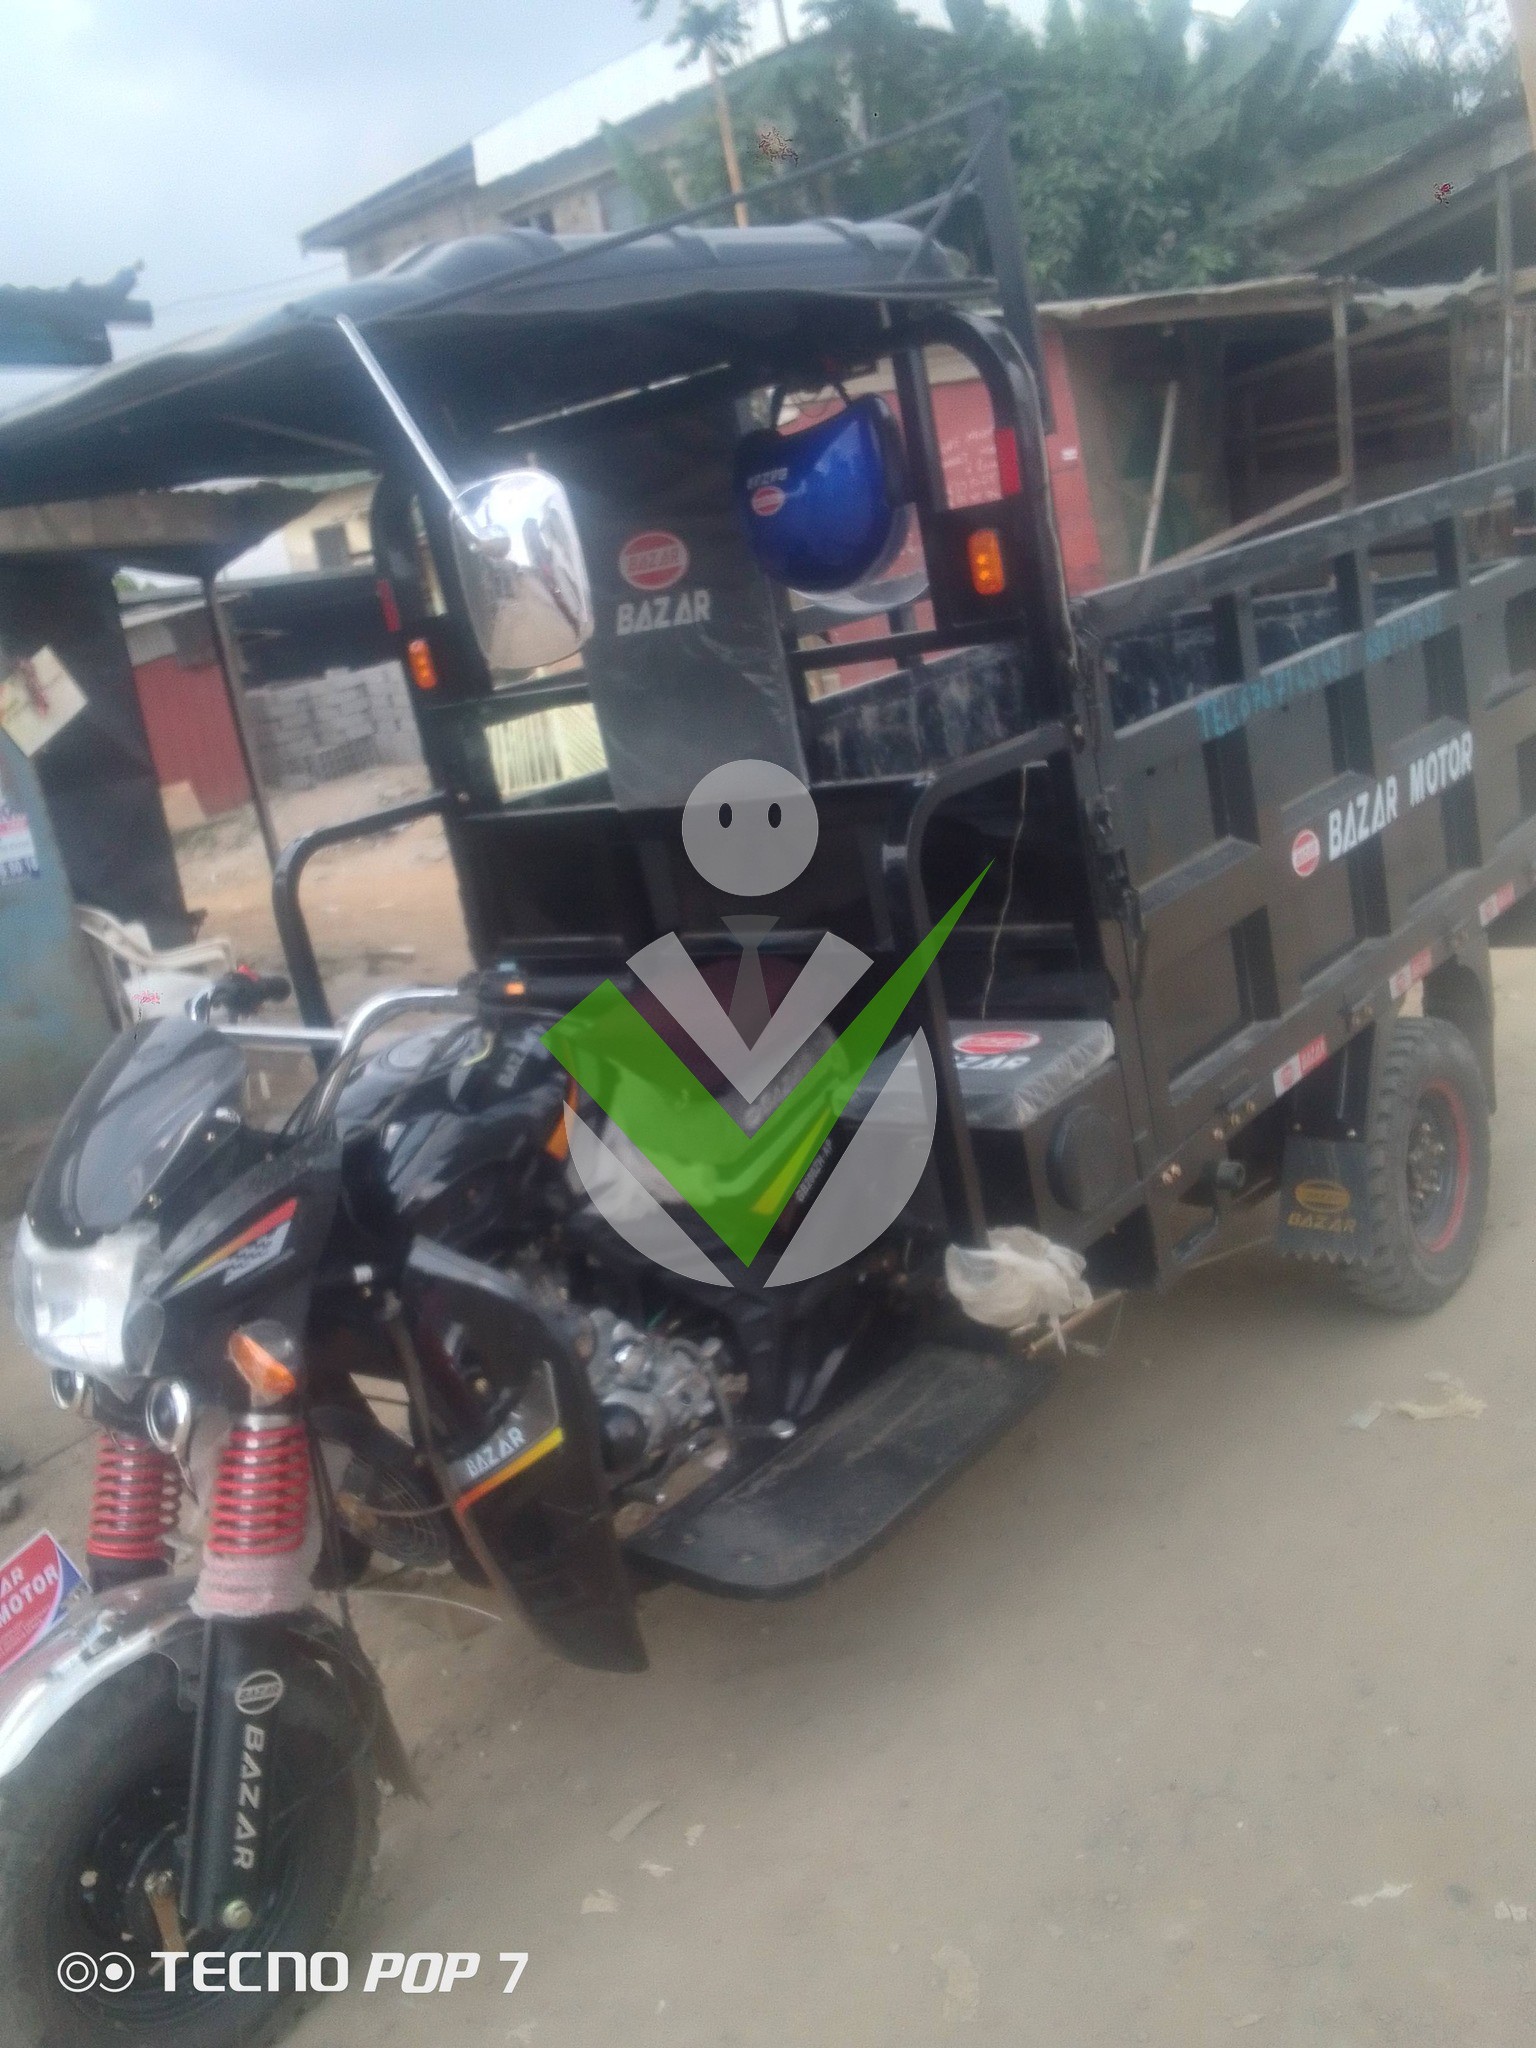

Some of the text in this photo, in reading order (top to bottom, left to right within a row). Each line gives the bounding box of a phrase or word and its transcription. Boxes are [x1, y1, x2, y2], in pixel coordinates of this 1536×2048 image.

[616, 590, 711, 636] BAZAR
[1329, 730, 1473, 861] BAZAR MOTOR
[1287, 1211, 1357, 1233] BAZAR
[466, 1426, 526, 1478] BAZAR
[233, 1724, 265, 1870] BAZAR
